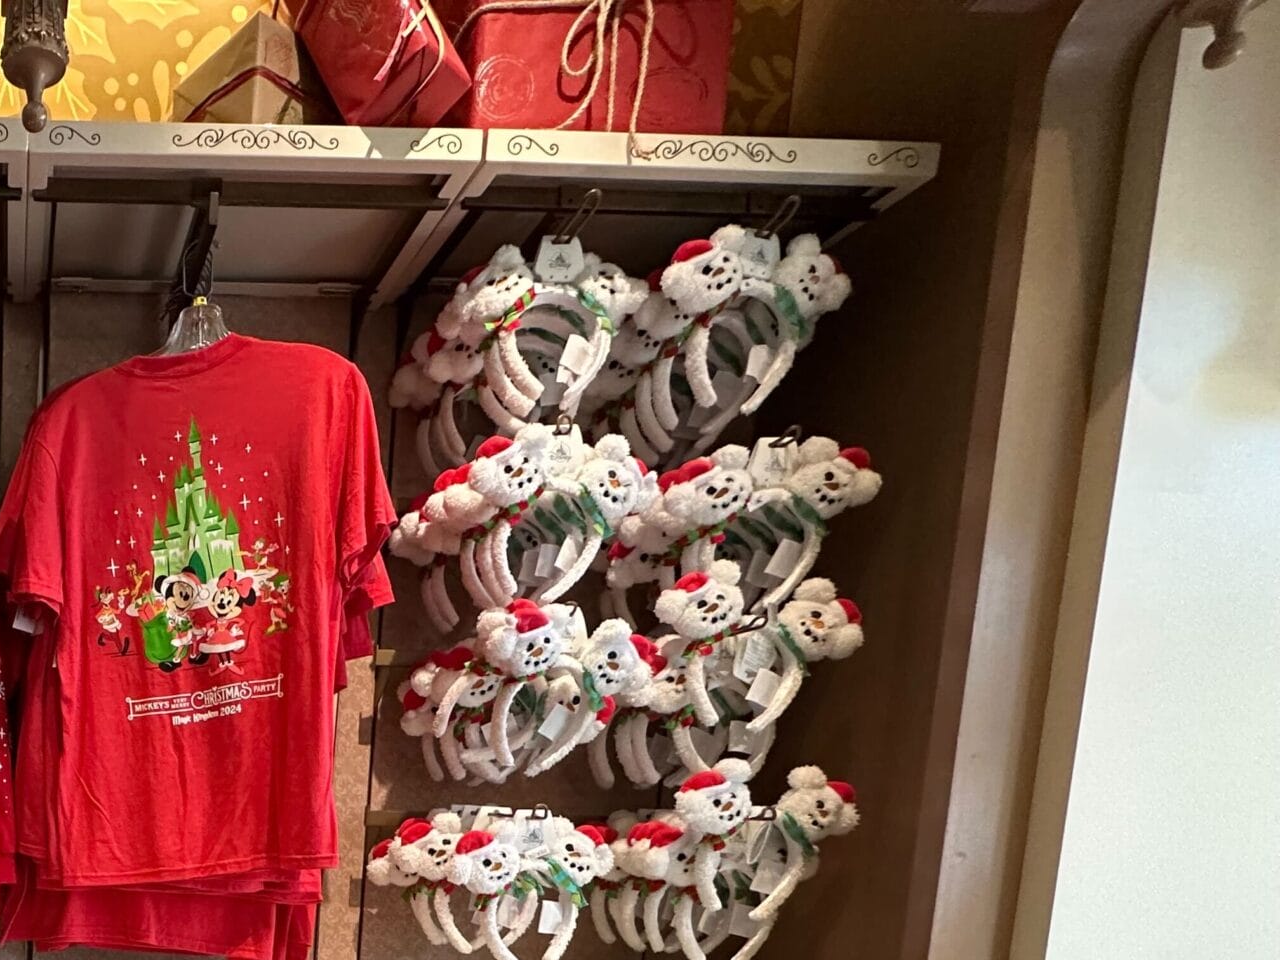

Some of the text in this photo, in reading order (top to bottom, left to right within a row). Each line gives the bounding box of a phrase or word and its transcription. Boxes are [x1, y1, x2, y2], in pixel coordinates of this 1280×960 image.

[191, 681, 277, 710] CHRISTMAS PARTY
[220, 703, 242, 717] 2024
